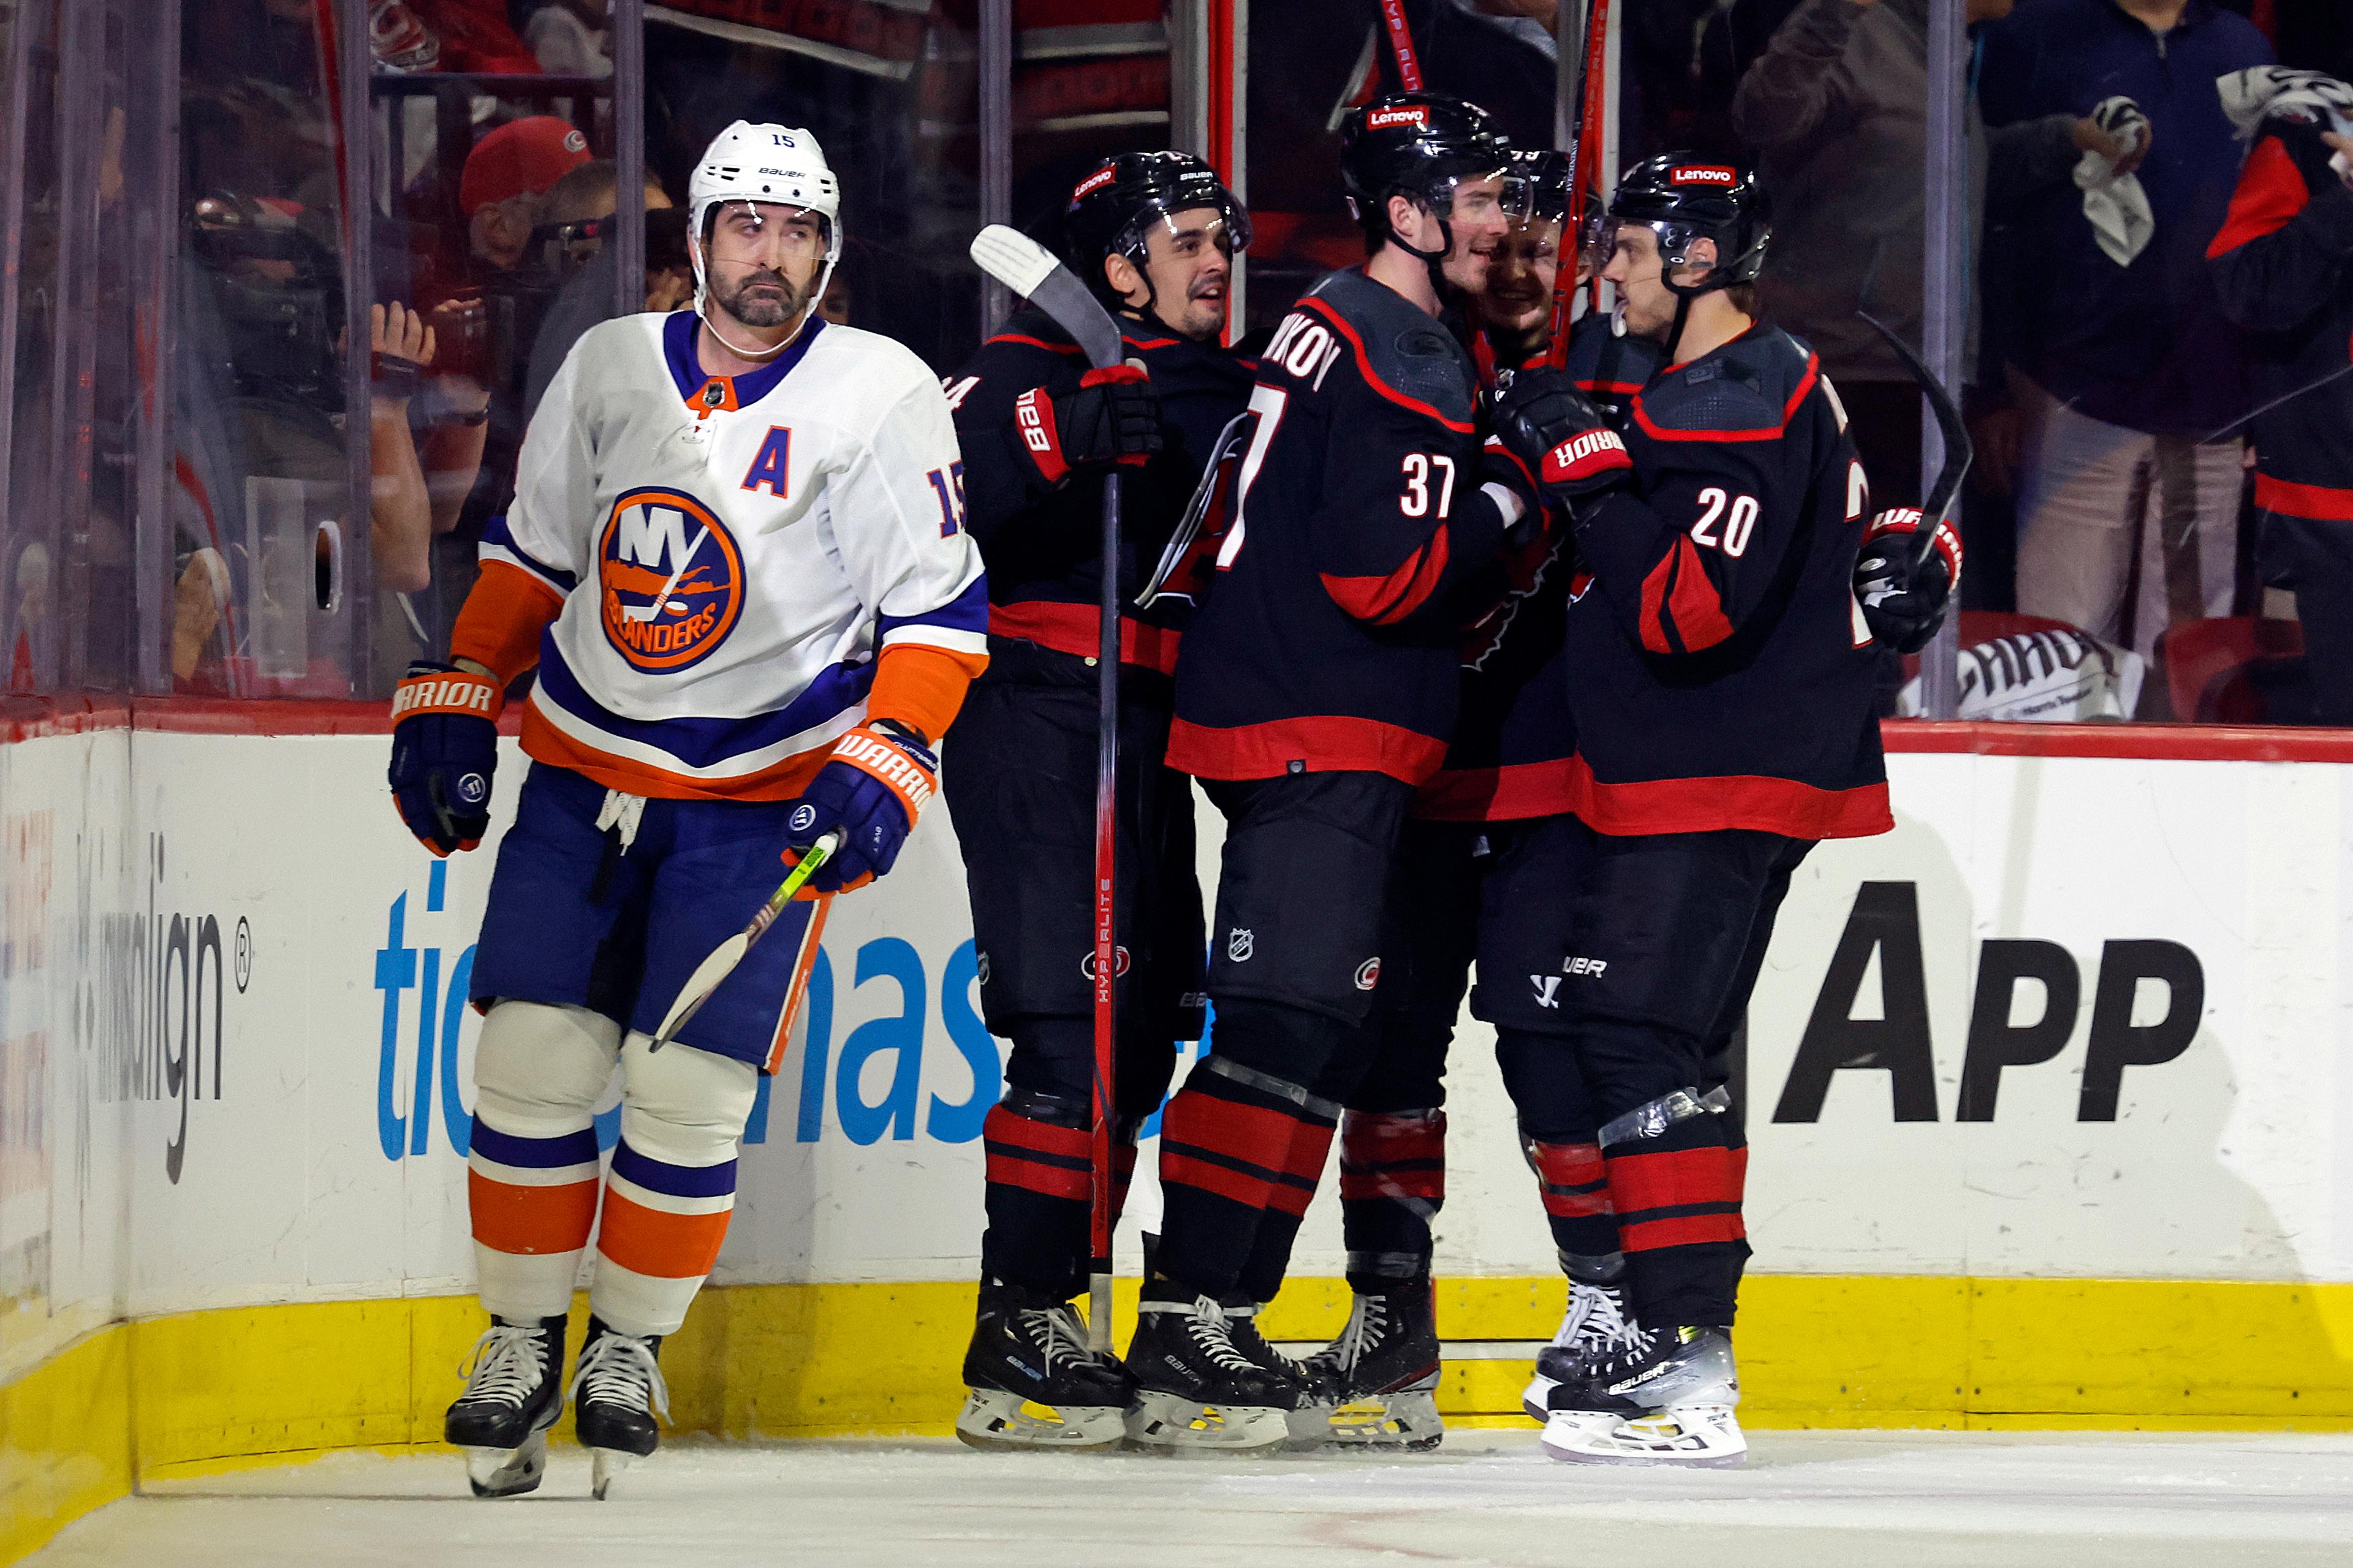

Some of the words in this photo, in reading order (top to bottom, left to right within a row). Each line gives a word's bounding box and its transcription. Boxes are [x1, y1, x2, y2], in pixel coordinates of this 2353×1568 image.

[1371, 110, 1424, 124] Lenovo
[771, 134, 795, 148] 15
[1075, 171, 1112, 197] Lenovo
[1676, 170, 1731, 181] Lenovo
[740, 425, 792, 499] A
[1400, 452, 1455, 518] 37
[1689, 487, 1760, 558] 20
